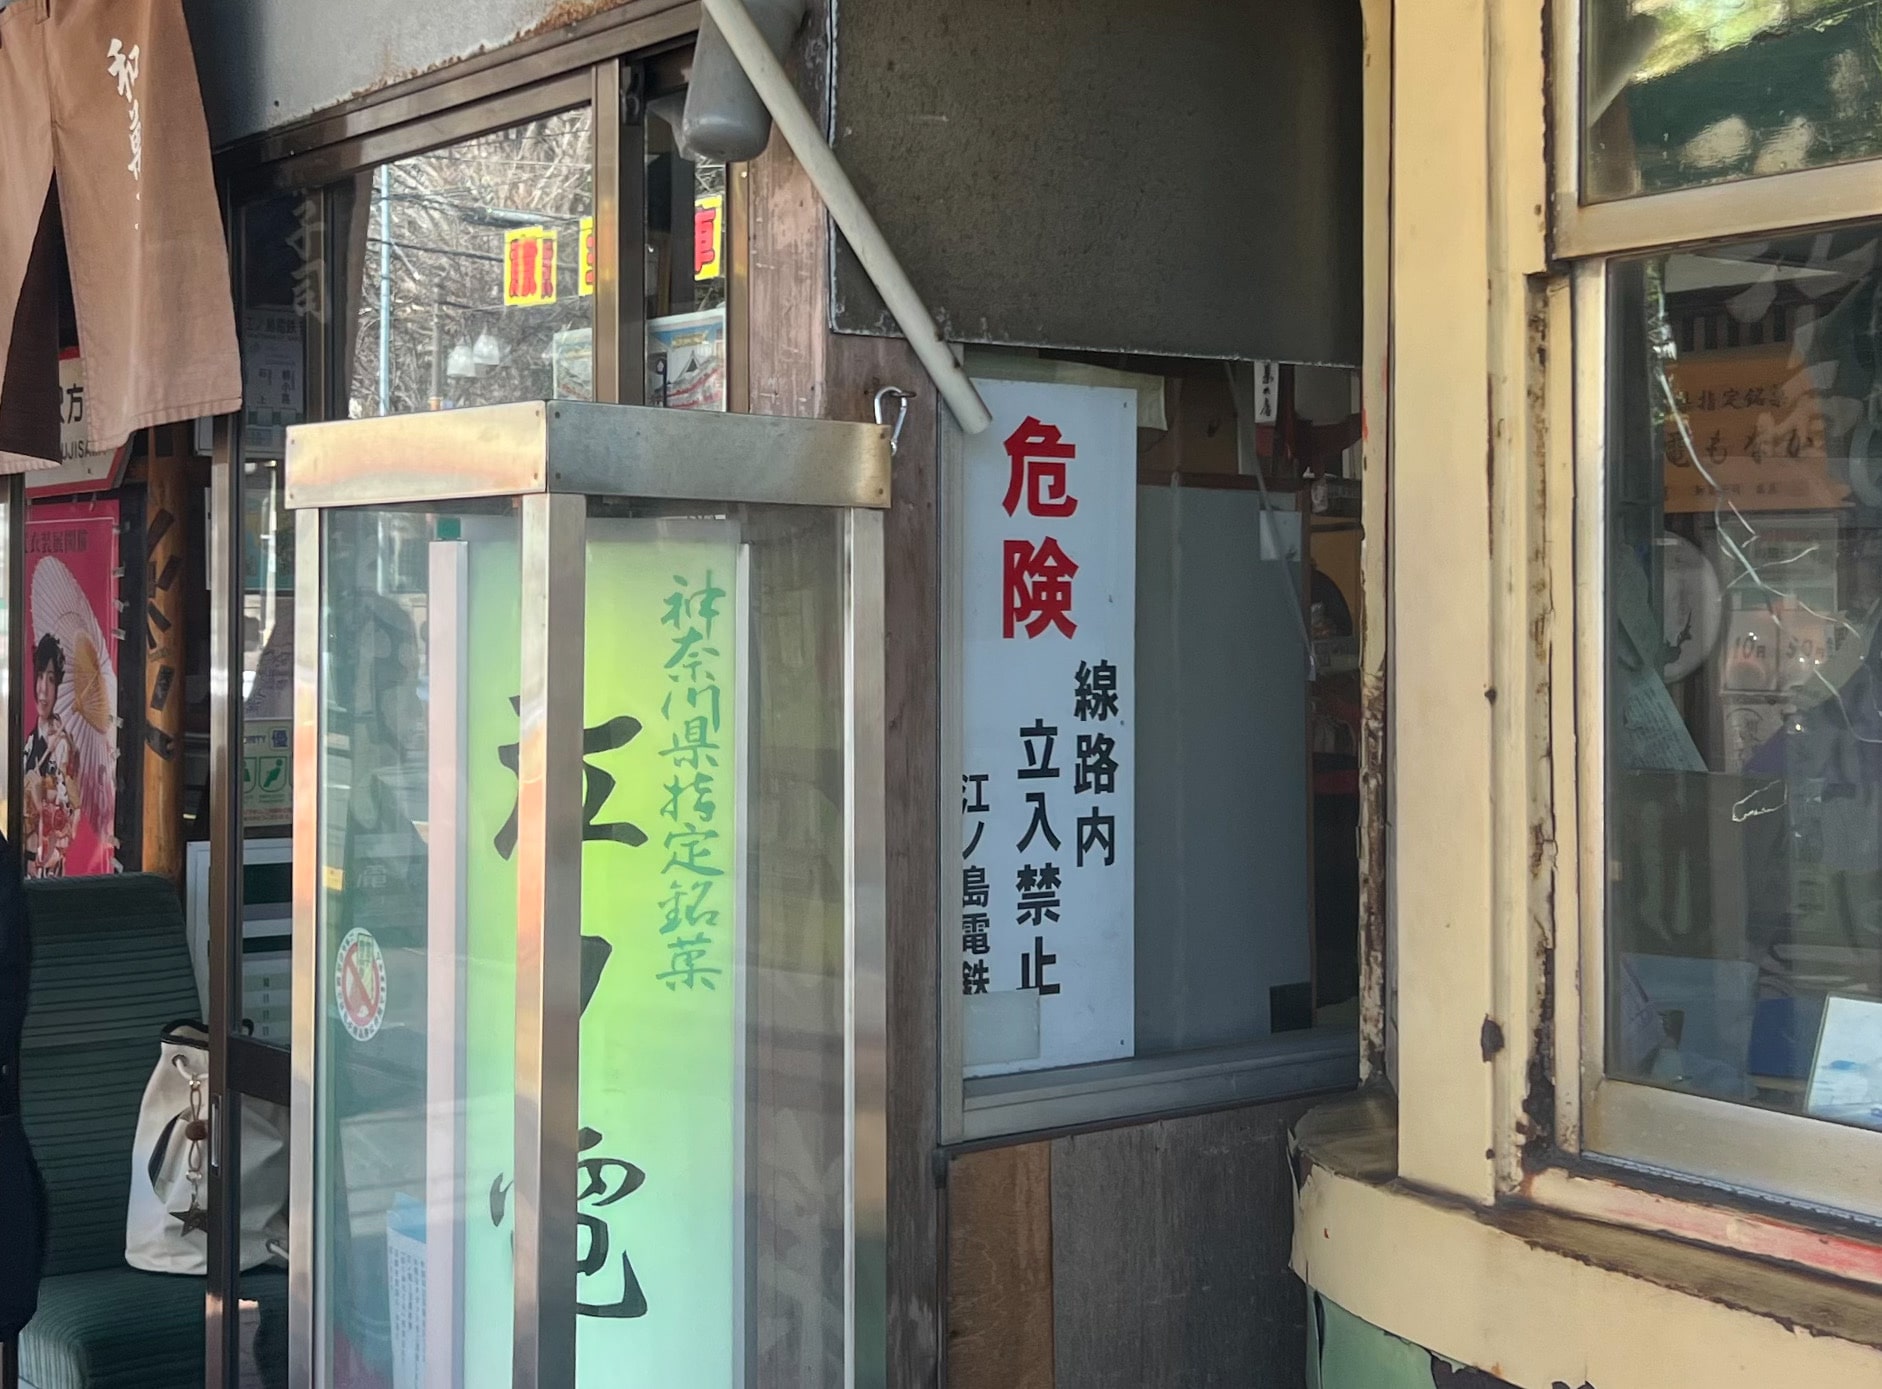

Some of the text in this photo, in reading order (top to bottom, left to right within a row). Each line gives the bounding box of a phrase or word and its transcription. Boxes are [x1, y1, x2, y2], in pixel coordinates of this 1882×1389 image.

[1002, 415, 1079, 640] 危険
[656, 569, 726, 992] 神奈川県指定銘菓
[1016, 718, 1061, 995] 立入禁止
[1074, 659, 1119, 867] 線路内
[962, 773, 991, 995] 江ノ島電鉄
